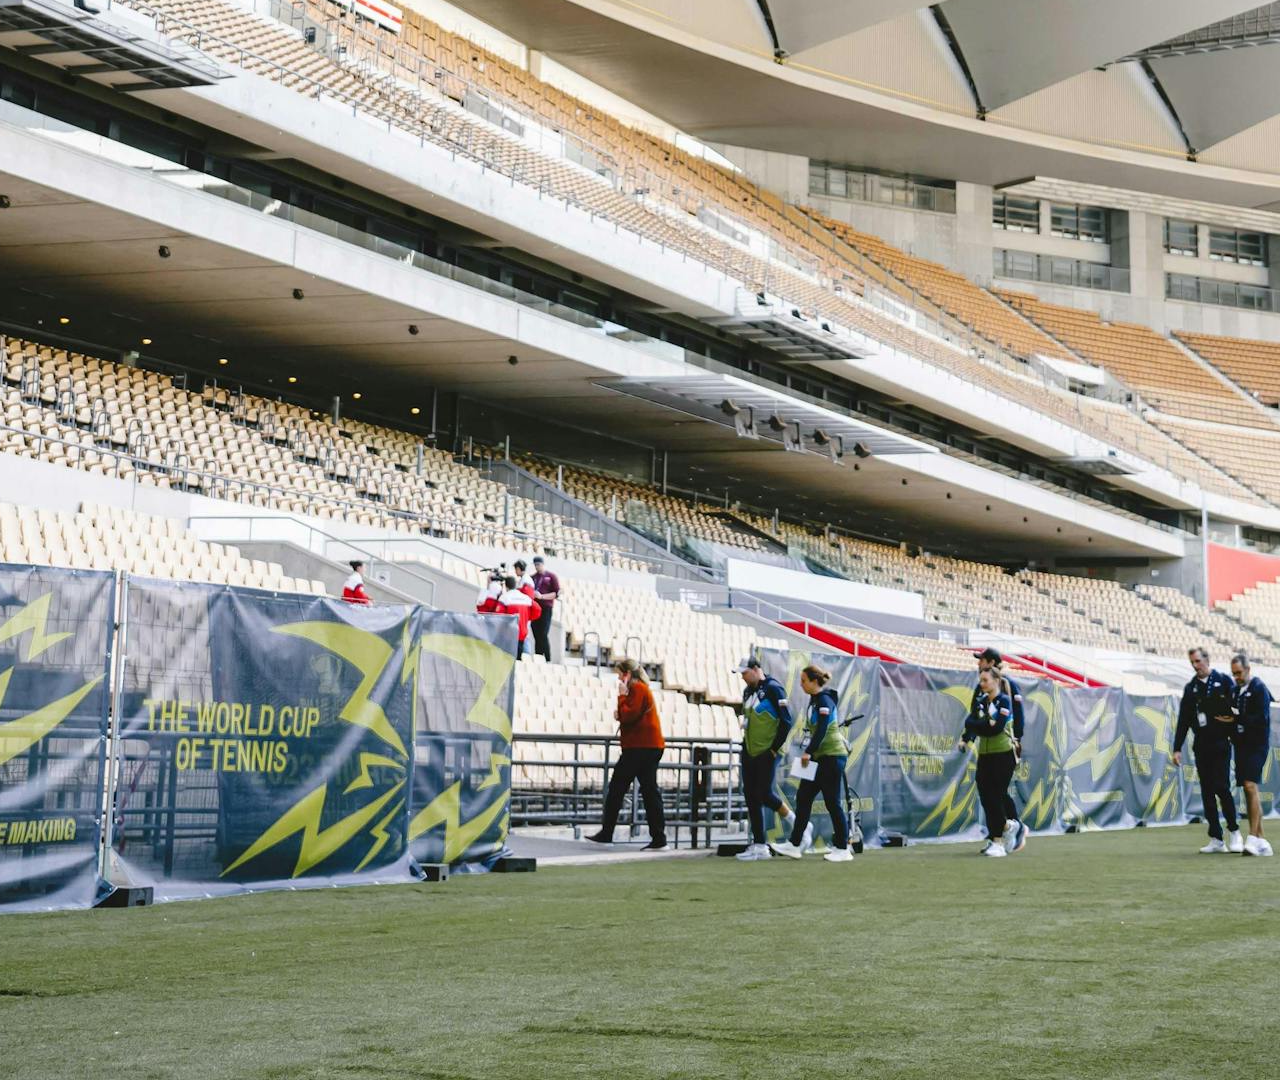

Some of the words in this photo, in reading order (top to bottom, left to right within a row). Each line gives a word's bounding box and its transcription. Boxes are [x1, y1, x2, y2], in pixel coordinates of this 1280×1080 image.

[143, 699, 191, 733] THE
[197, 700, 274, 737] WORLD
[279, 705, 320, 738] CUP
[176, 738, 203, 771] OF
[209, 738, 288, 772] TENNIS
[914, 755, 945, 776] TENNIS
[7, 817, 77, 844] MAKING
